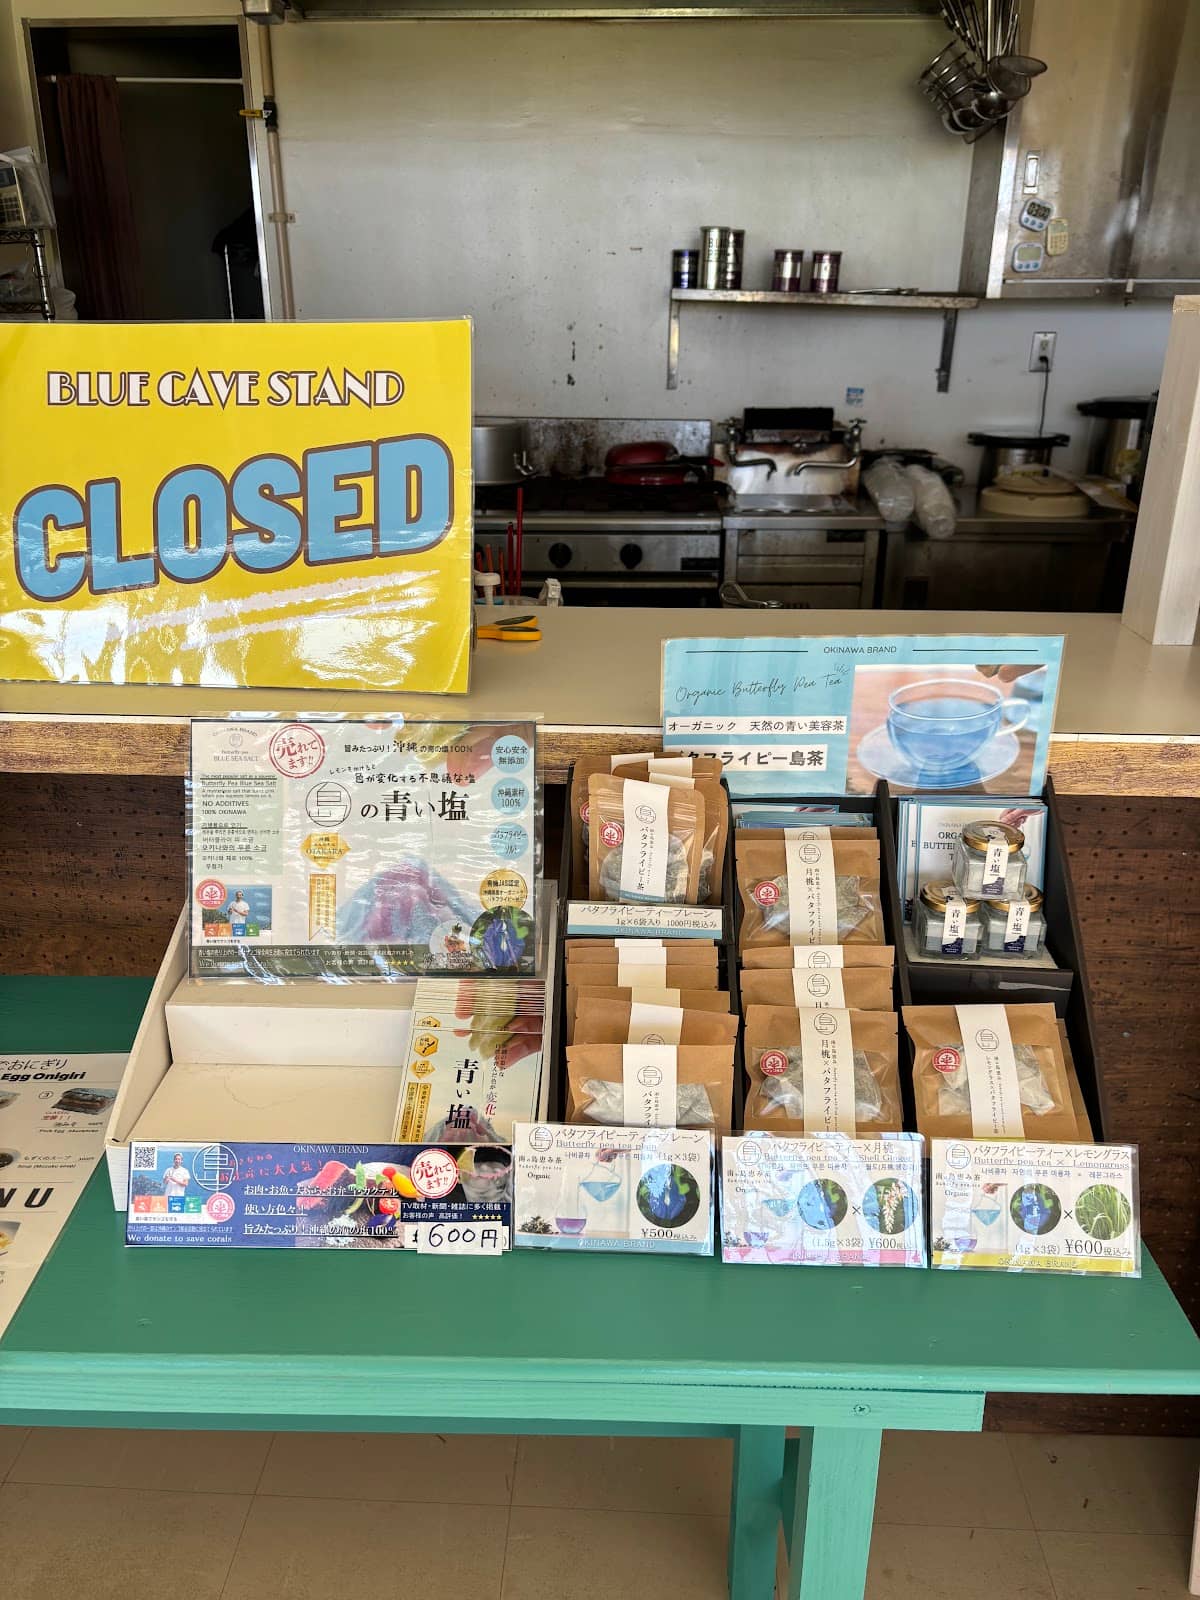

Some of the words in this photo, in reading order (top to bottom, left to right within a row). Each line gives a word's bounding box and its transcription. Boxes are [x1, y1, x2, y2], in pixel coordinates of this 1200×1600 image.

[47, 371, 150, 406] BLUE
[158, 367, 259, 409] CAVE
[267, 367, 405, 409] STAND
[14, 433, 454, 602] CLOSED
[823, 646, 863, 655] OKINAWA
[867, 646, 897, 654] BRAND
[732, 678, 786, 697] Butterfly
[824, 673, 842, 688] Tea
[668, 721, 737, 731] オーガニック
[750, 720, 845, 732] 天然の青い美容茶
[276, 737, 318, 760] 売れて
[496, 746, 527, 754] 安心安全
[498, 757, 524, 765] 無添加
[682, 750, 824, 767] タフライピー島茶
[502, 798, 520, 807] 100%
[1, 1073, 31, 1082] Egg
[33, 1071, 86, 1081] Onigiri
[445, 1058, 479, 1130] 青い塩
[293, 1145, 336, 1154] OKINAWA
[338, 1145, 369, 1154] BRAND
[557, 1140, 596, 1149] Butterfly
[974, 1157, 1014, 1165] Butterfly
[416, 1161, 452, 1181] 売れて
[528, 1171, 550, 1180] Organic
[127, 1234, 140, 1242] We
[144, 1234, 172, 1242] donate
[207, 1234, 232, 1243] corals
[428, 1223, 498, 1249] 600円
